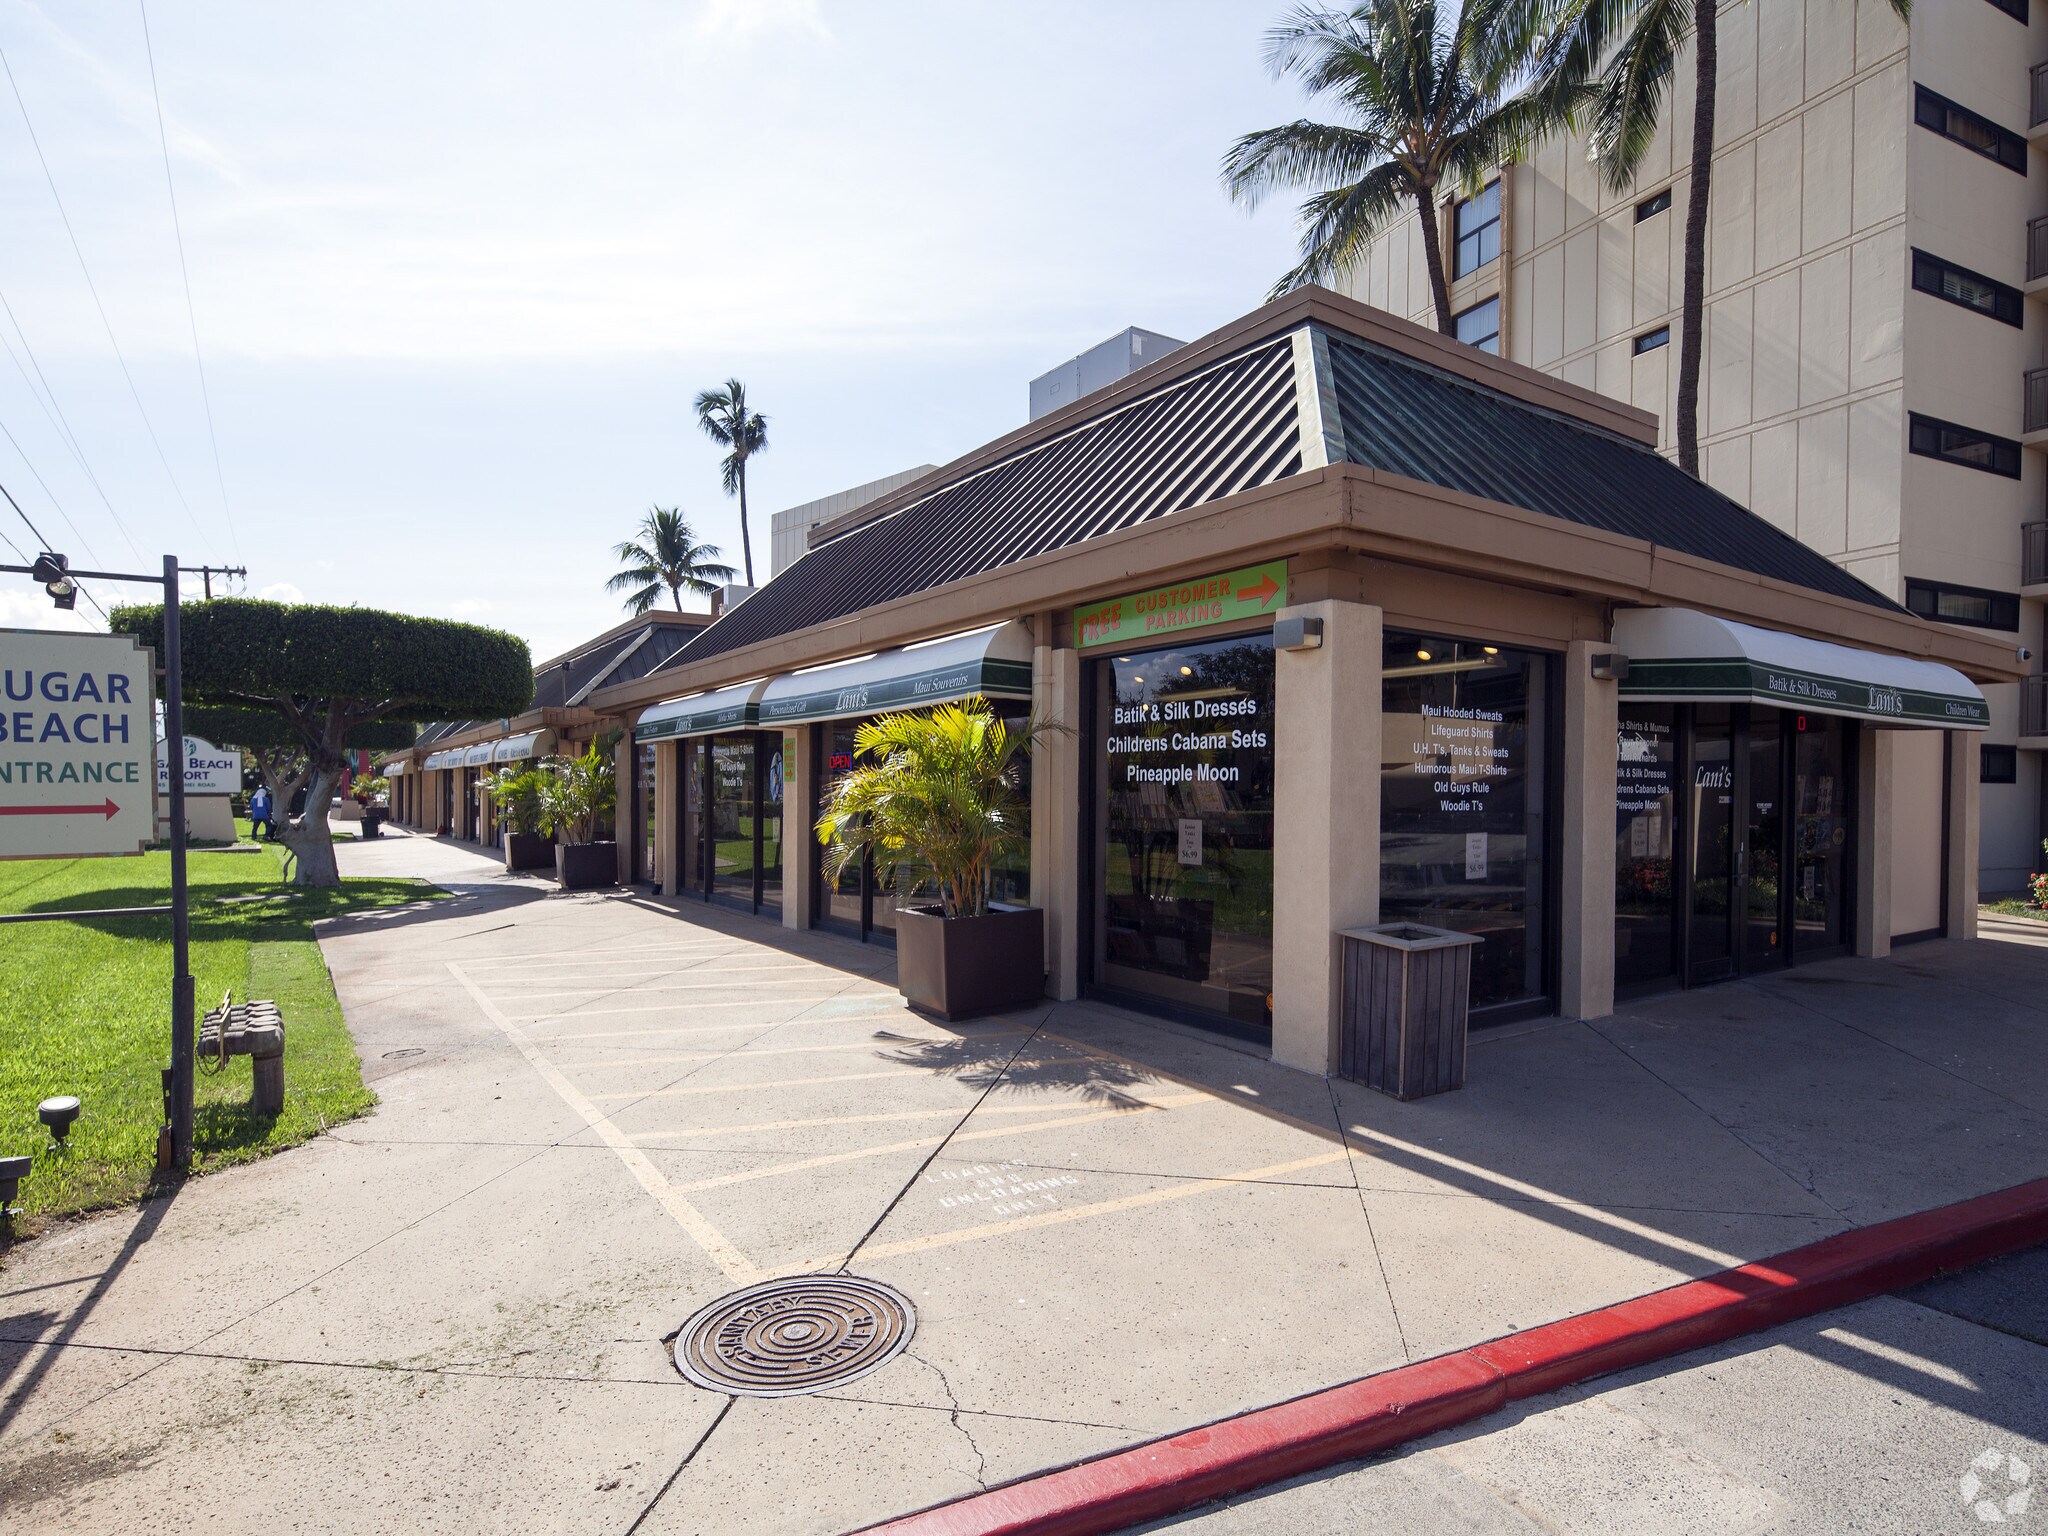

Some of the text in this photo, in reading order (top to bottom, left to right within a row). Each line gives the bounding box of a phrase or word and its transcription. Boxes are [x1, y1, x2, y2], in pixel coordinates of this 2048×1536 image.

[1078, 578, 1231, 645] FREE CUSTOMER
[1145, 601, 1222, 631] PARKING
[0, 670, 132, 703] UGAR
[768, 701, 798, 716] Personalized
[835, 685, 869, 712] Lani's
[913, 681, 932, 695] Maui
[931, 673, 968, 691] Souvenirs
[1768, 674, 1981, 717] Batik & Silk Dresses Lani's Children Wear
[1114, 699, 1257, 724] Batik & Silk Dresses
[1421, 704, 1503, 722] Maui Hooded Sweats
[675, 717, 692, 734] Lani's
[1431, 724, 1493, 739] Lifeguard Shirts
[1625, 720, 1643, 731] Shirts
[1644, 721, 1649, 731] &
[1107, 729, 1267, 753] Childrens Cabana Sets
[1413, 742, 1509, 758] U.H. T's, Tanks & Sweats
[189, 758, 233, 769] BEACH
[830, 755, 851, 769] OPEN
[1414, 762, 1507, 776] Humorous Maui T-Shirts
[160, 771, 210, 780] RORT
[1127, 763, 1239, 785] Pineapple Moon
[1617, 768, 1666, 779] tik & Silk Dresses
[1695, 765, 1732, 788] Lani's
[1434, 781, 1490, 796] Old Guys Rule
[1617, 784, 1670, 794] drens Cabana Sets
[1440, 800, 1483, 811] Woodie T's
[1616, 800, 1661, 811] Pineapple Moon
[1181, 851, 1198, 859] $6.99
[1469, 864, 1485, 874] $6.99
[805, 1315, 874, 1367] SEWER
